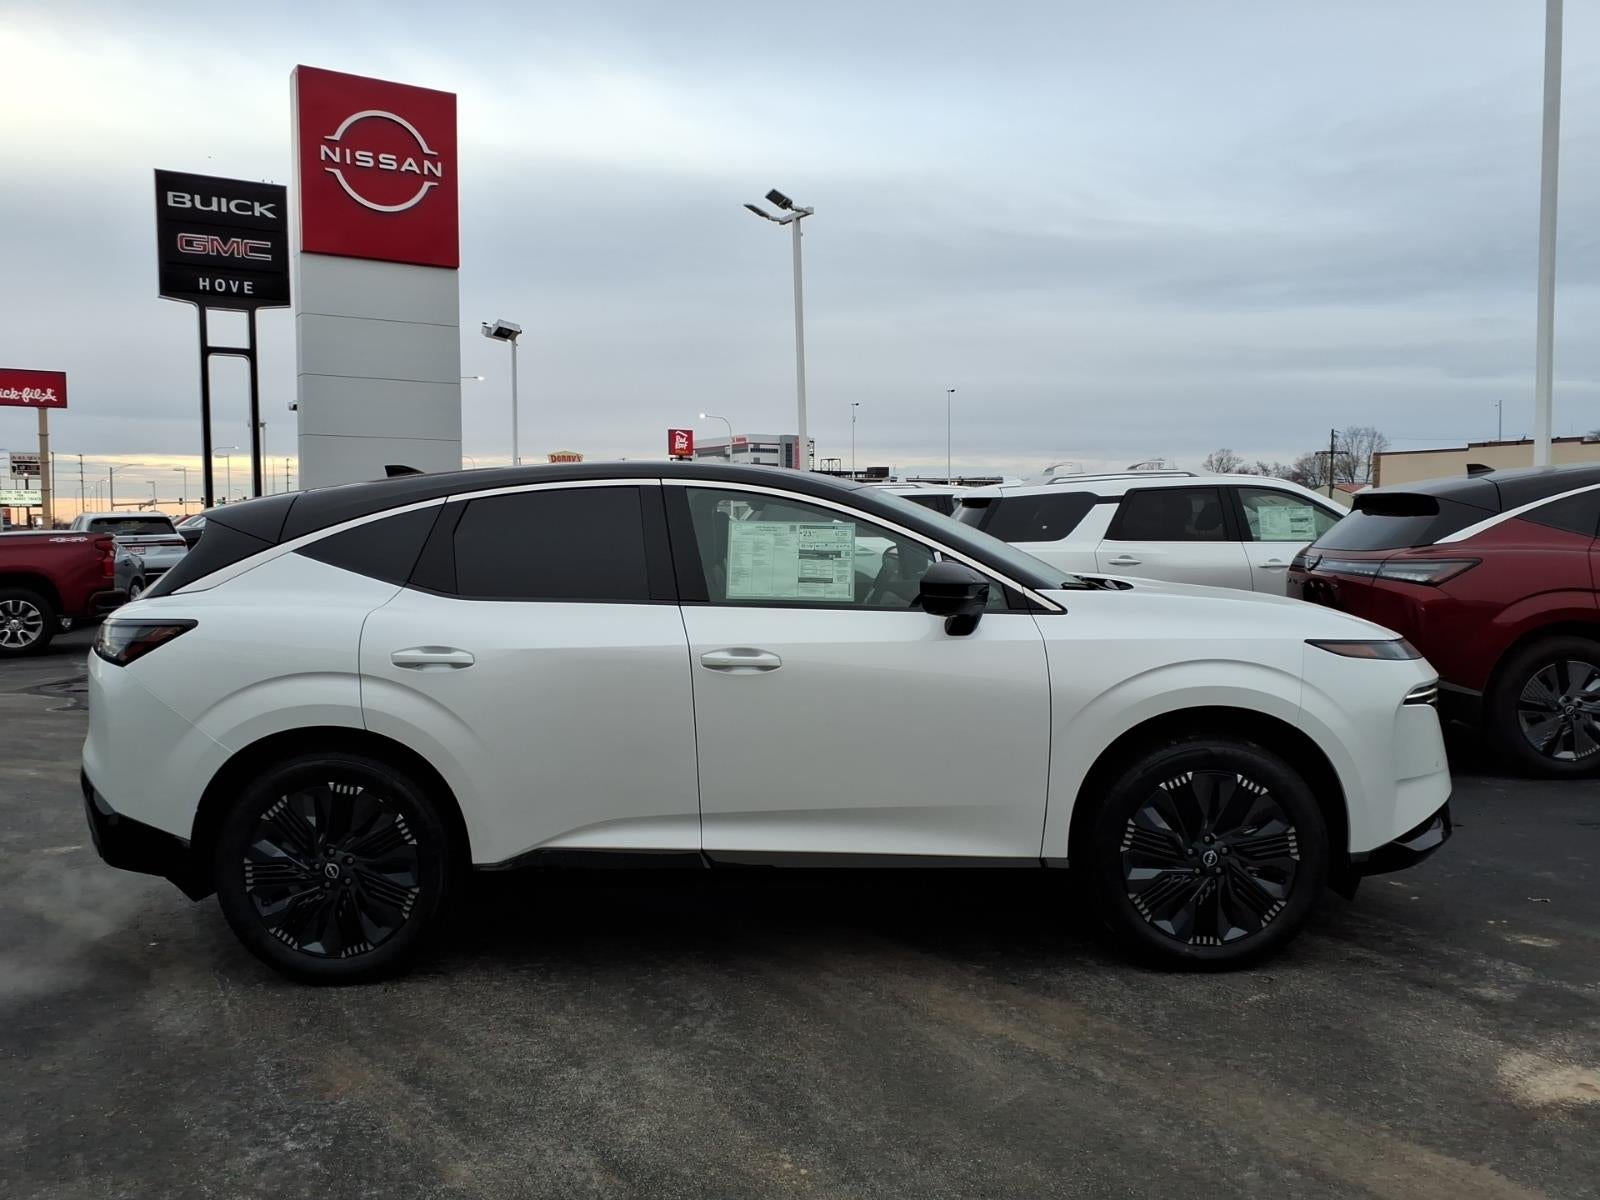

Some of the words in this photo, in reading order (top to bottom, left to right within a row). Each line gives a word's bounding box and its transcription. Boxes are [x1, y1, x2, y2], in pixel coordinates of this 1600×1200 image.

[320, 144, 442, 177] NISSAN
[167, 191, 277, 219] BUICK
[177, 233, 272, 261] GMC
[199, 277, 254, 294] HOVE
[0, 387, 57, 402] ick-fil-A
